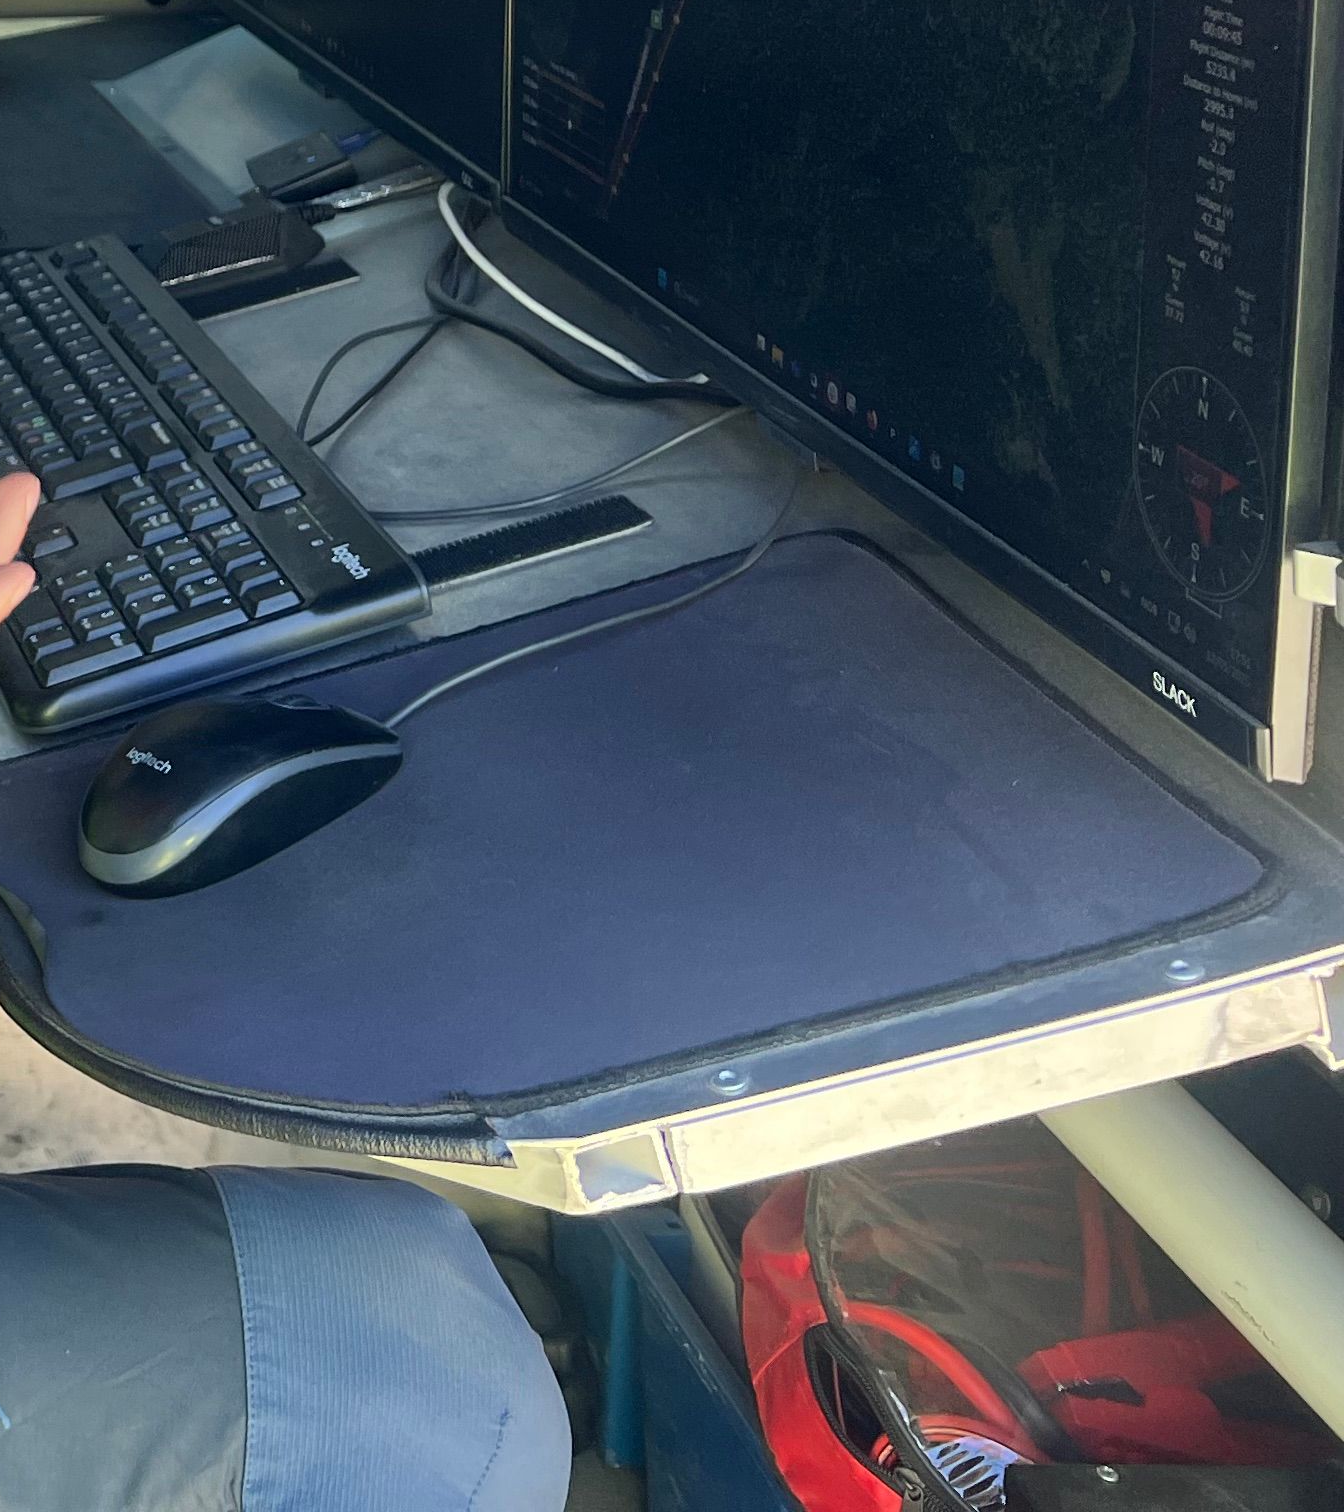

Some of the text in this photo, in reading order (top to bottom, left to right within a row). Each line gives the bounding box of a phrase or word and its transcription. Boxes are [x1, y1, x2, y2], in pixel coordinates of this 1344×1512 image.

[1197, 398, 1209, 421] N
[1150, 444, 1165, 468] W
[1240, 496, 1251, 520] E
[331, 542, 372, 580] logitech
[1190, 542, 1201, 562] S
[1152, 671, 1197, 717] SLACK
[125, 746, 172, 774] logitech
